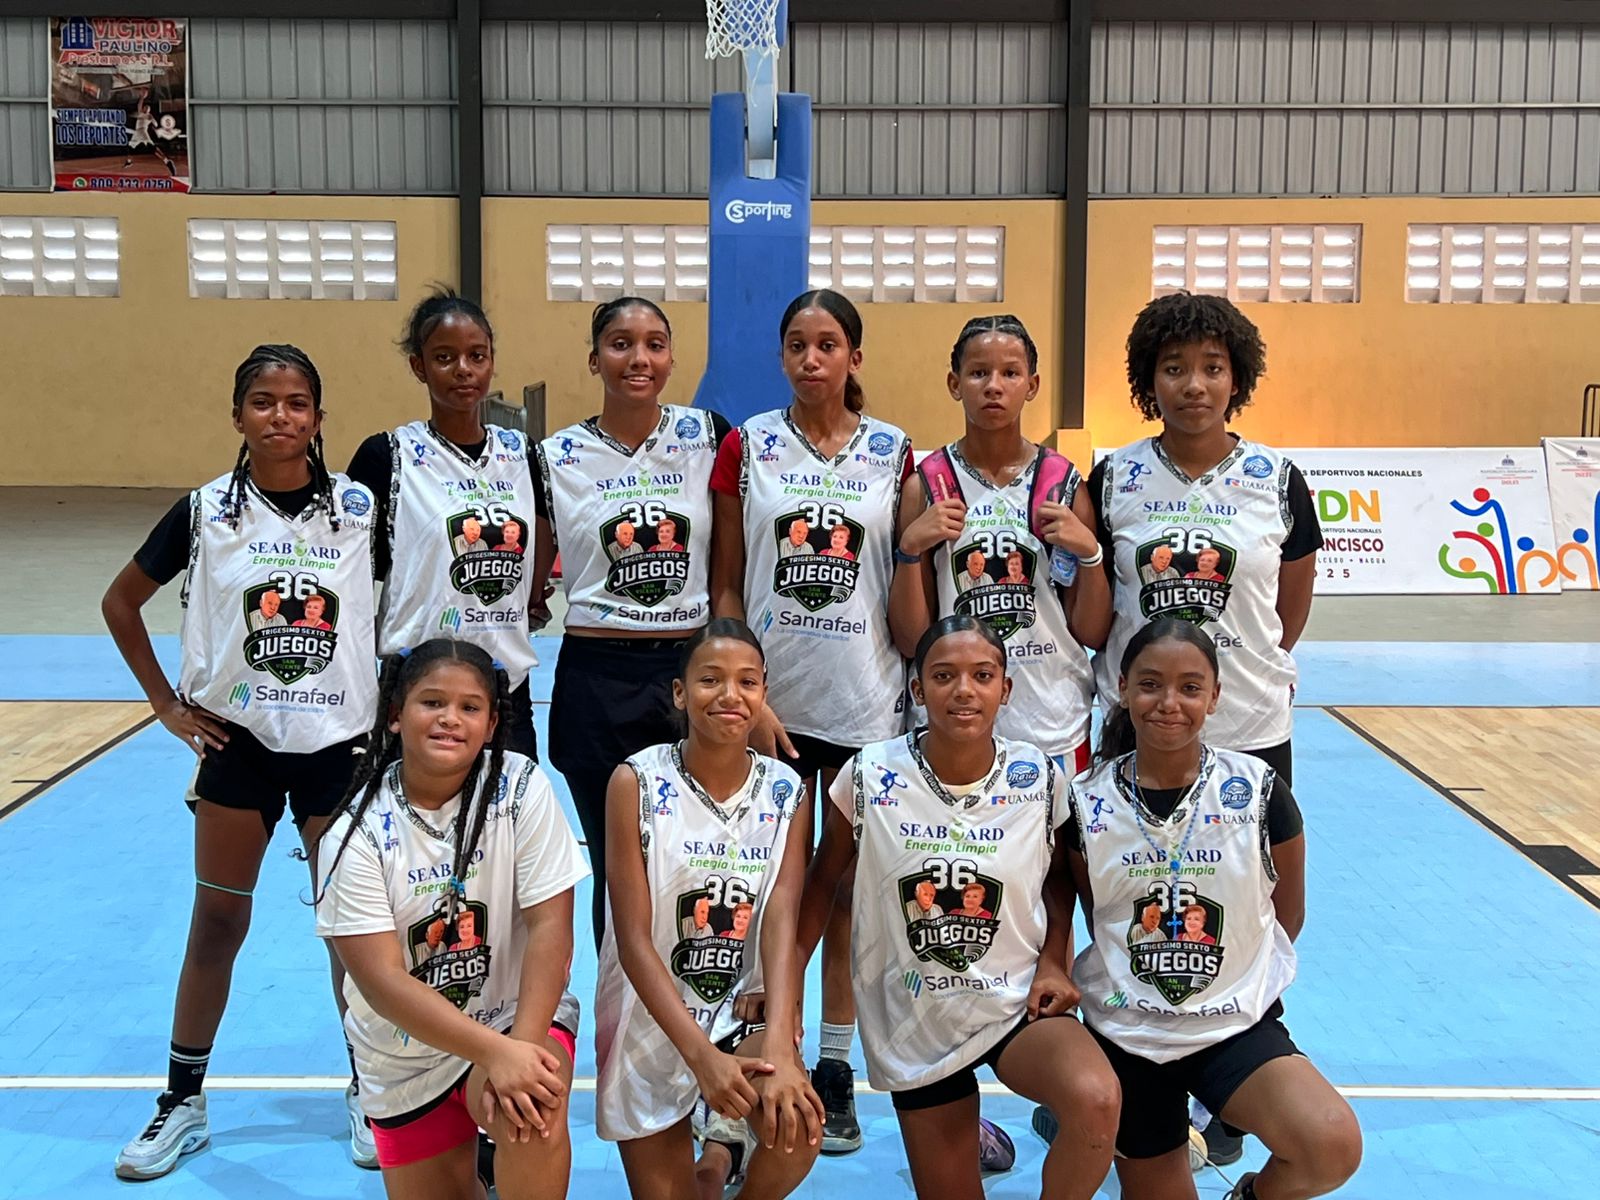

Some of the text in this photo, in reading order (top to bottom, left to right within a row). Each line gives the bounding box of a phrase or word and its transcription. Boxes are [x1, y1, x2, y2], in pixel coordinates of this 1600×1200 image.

[93, 18, 177, 39] VICTOR
[100, 40, 172, 53] PAULINO
[56, 126, 128, 145] LOS DEPORTES
[596, 470, 683, 492] SEABOARD
[779, 472, 867, 493] SEABOARD
[1310, 469, 1365, 477] DEPORTIVOS
[1367, 469, 1423, 477] NACIONALES
[645, 486, 679, 497] Limpia
[826, 489, 862, 502] Limpia
[466, 502, 511, 527] 36
[620, 500, 667, 529] 36
[798, 501, 845, 530] 36
[966, 502, 1027, 519] ABOAR
[1143, 497, 1238, 516] SEABOARD
[1309, 488, 1382, 523] DN
[964, 517, 997, 529] nergía
[1193, 514, 1232, 527] Limpia
[248, 538, 341, 560] SEABOARD
[972, 531, 1018, 559] 36
[1162, 527, 1213, 554] 36
[1320, 538, 1384, 552] NCISCO
[299, 556, 336, 571] Limpia
[500, 552, 520, 560] SEXTO
[789, 556, 850, 567] TRIGESIMO SEXTO
[460, 560, 522, 584] JUEGOS
[613, 560, 686, 587] JUEGOS
[780, 565, 855, 587] JUEGOS
[269, 570, 320, 601] 36
[1195, 580, 1219, 588] SEXTO
[969, 593, 1035, 615] JUEGOS
[1149, 588, 1225, 611] JUEGOS
[618, 603, 701, 623] Sanrafael
[779, 611, 866, 634] Sanrafael
[261, 627, 326, 637] TRIGESIMO SEXTO
[253, 636, 332, 660] JUEGOS
[1008, 640, 1057, 657] rafael
[255, 685, 345, 706] Sanrafael
[1204, 814, 1257, 825] RUAMA
[900, 821, 1004, 841] SEABOARD
[955, 842, 997, 856] Limpia
[408, 849, 484, 885] SEABD
[922, 857, 978, 891] 36
[704, 874, 750, 909] 36
[1147, 880, 1198, 913] 36
[959, 915, 986, 925] SEXTO
[728, 940, 744, 948] SEX
[915, 923, 992, 951] JUEGOS
[1140, 942, 1210, 952] TRIGESIMO SEXTO
[682, 948, 742, 970] JUEGO
[1138, 951, 1218, 975] JUEGOS
